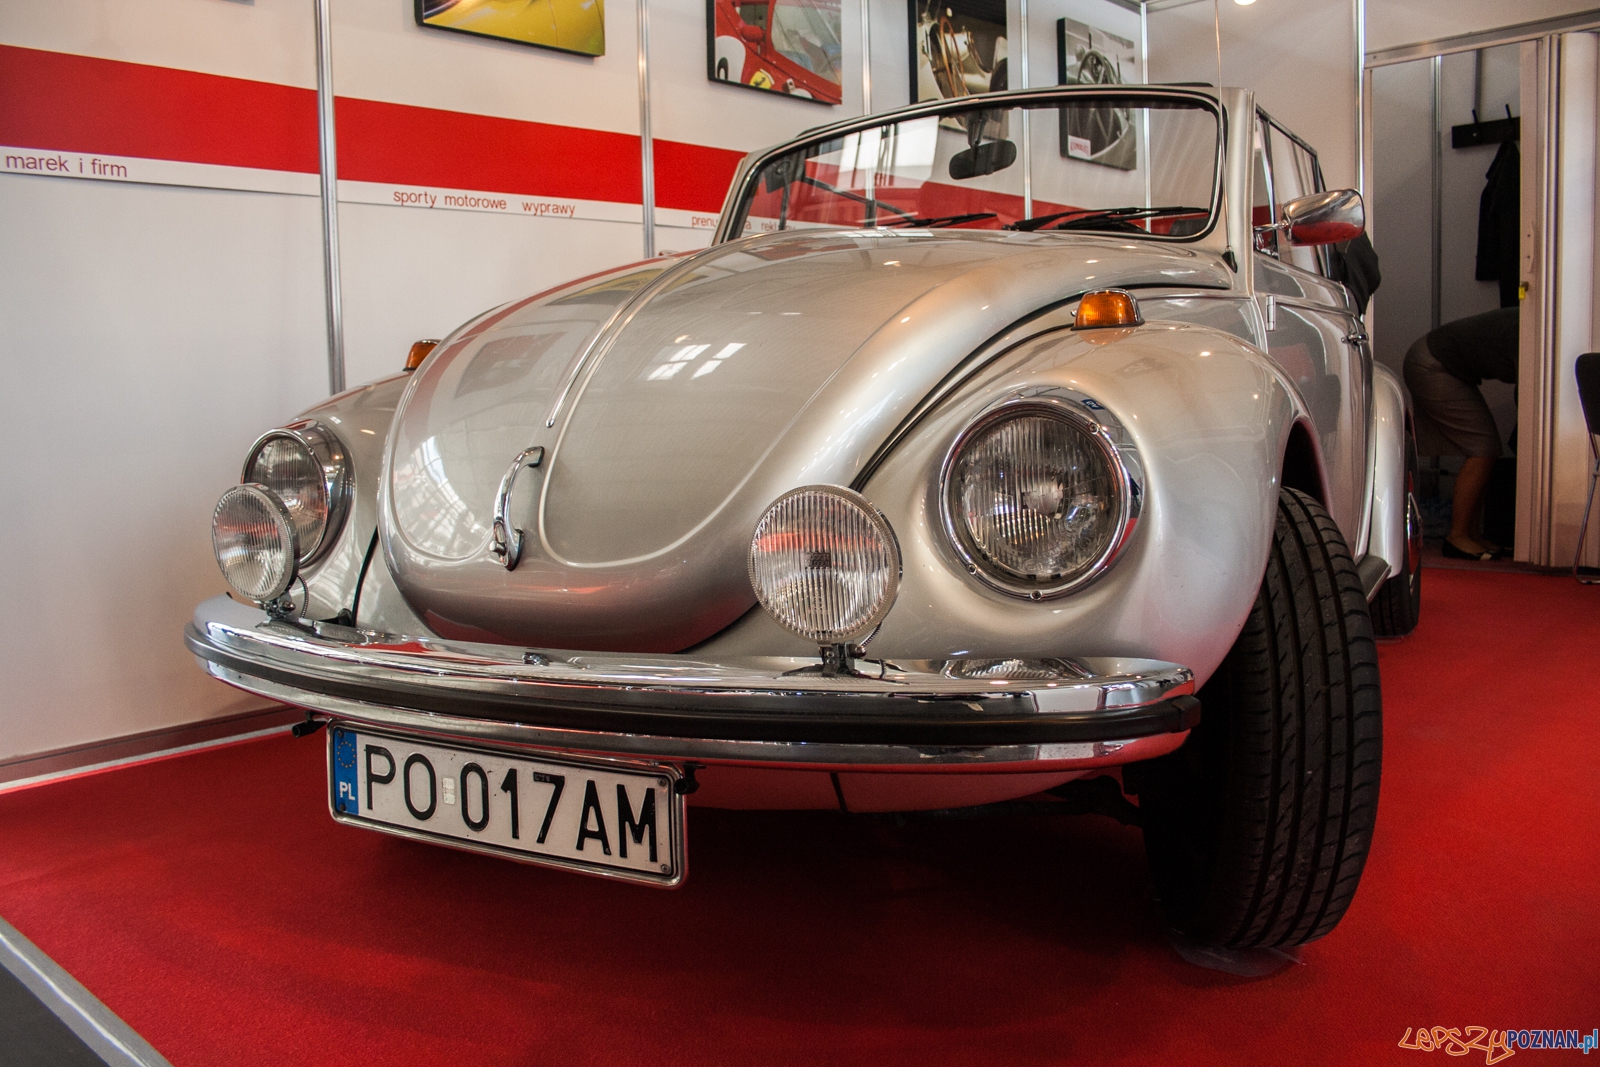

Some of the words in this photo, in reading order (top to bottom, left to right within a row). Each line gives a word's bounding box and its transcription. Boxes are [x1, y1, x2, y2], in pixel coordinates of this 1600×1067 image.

[5, 155, 70, 172] marek
[79, 157, 83, 173] i
[91, 158, 128, 178] firm
[393, 190, 437, 209] sporty
[444, 193, 508, 210] motorowe
[521, 200, 576, 219] wyprawy
[339, 781, 356, 801] PL
